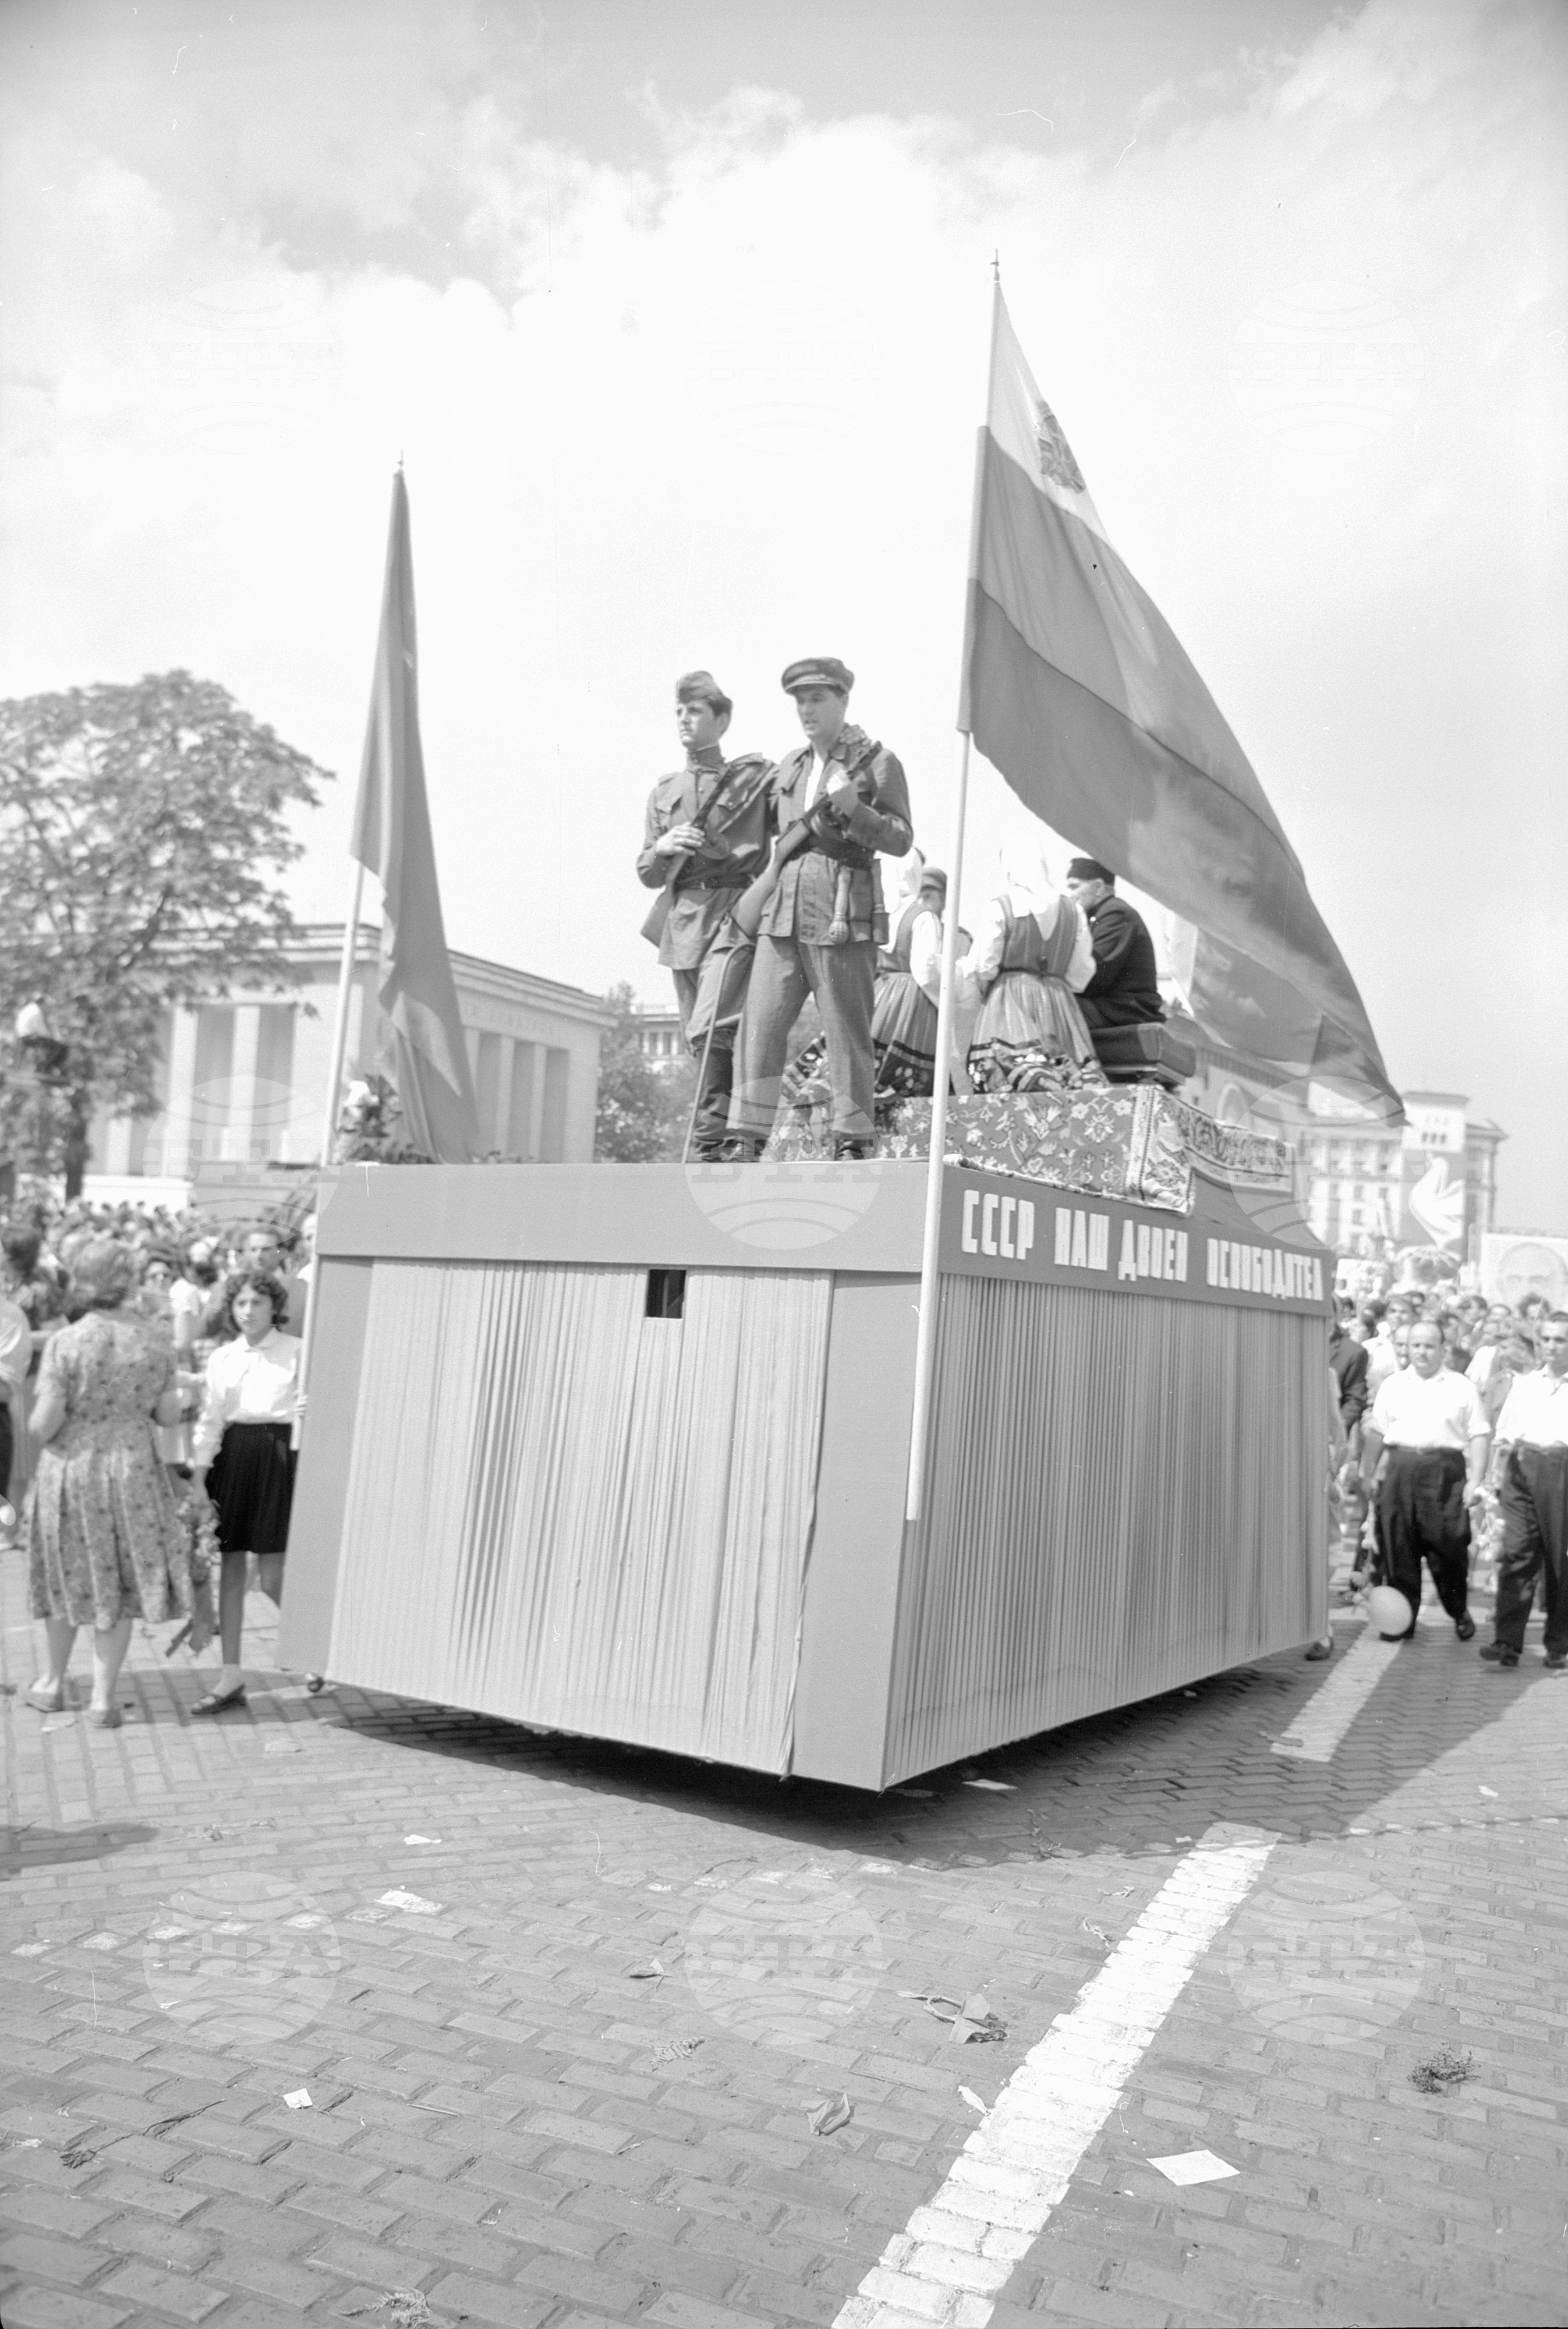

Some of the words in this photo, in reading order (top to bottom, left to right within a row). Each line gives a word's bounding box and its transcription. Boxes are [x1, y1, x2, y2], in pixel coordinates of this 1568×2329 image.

[962, 1190, 1035, 1260] СССР
[1054, 1208, 1109, 1270] НАШ
[1118, 1220, 1188, 1282] ДВОЕН
[1207, 1238, 1323, 1301] ОСВОБОДИТЕЛ
